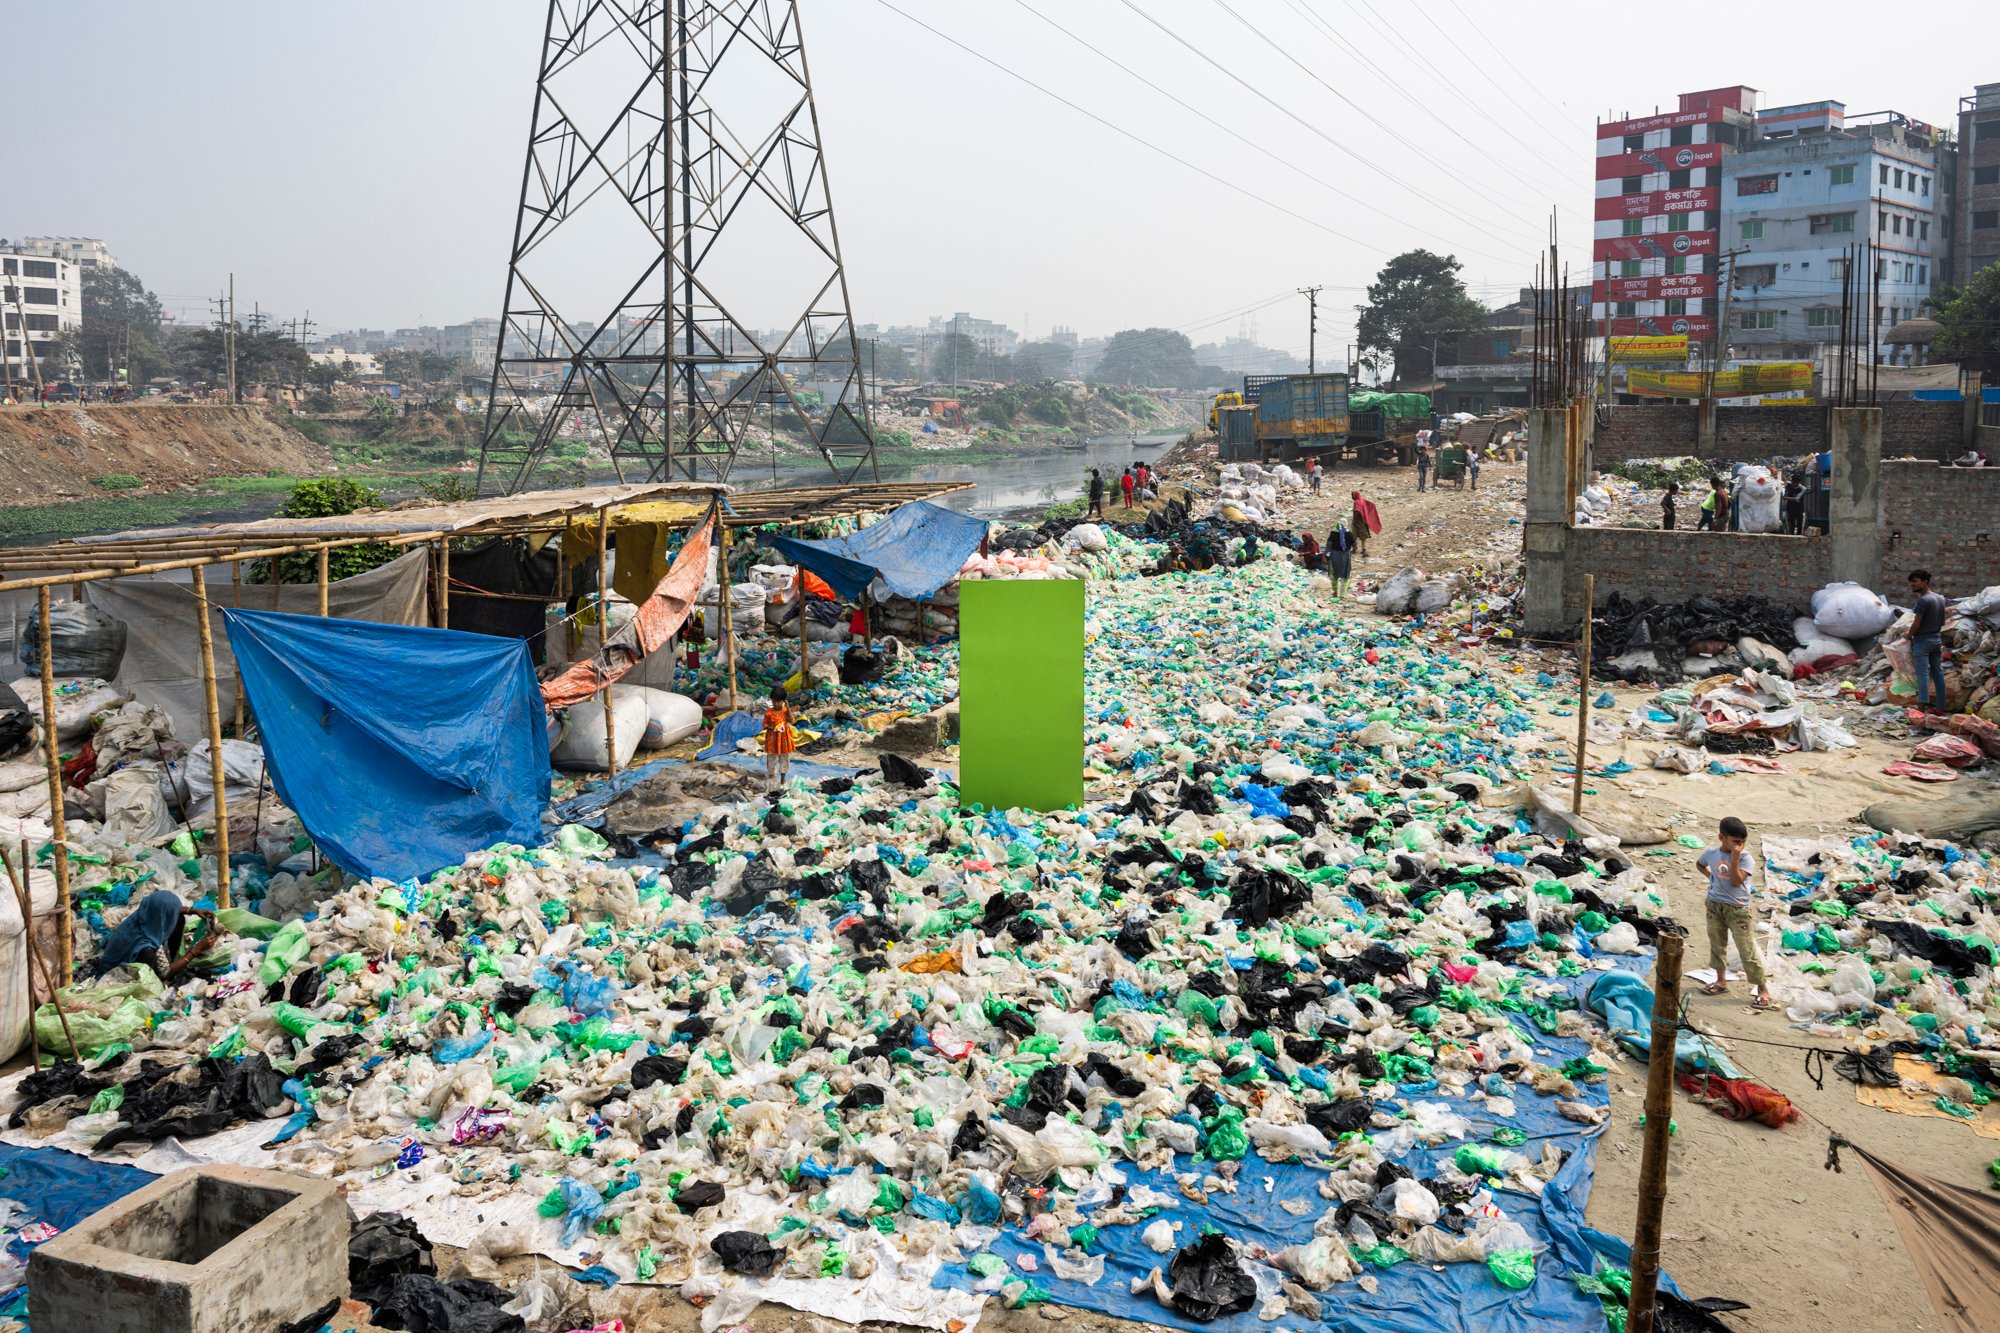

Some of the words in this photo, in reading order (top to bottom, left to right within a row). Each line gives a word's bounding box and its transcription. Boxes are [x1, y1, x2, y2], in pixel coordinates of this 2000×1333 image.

[1695, 152, 1713, 161] ispat
[1665, 191, 1681, 201] উচ্চ
[1682, 189, 1702, 199] শক্তি
[1664, 200, 1693, 211] একমাত্র
[1694, 199, 1708, 208] রড
[1692, 238, 1711, 247] ispat
[1660, 278, 1677, 287] উচ্চ
[1678, 276, 1697, 285] শক্তি
[1660, 287, 1690, 297] একমাত্র
[1691, 286, 1704, 295] রড
